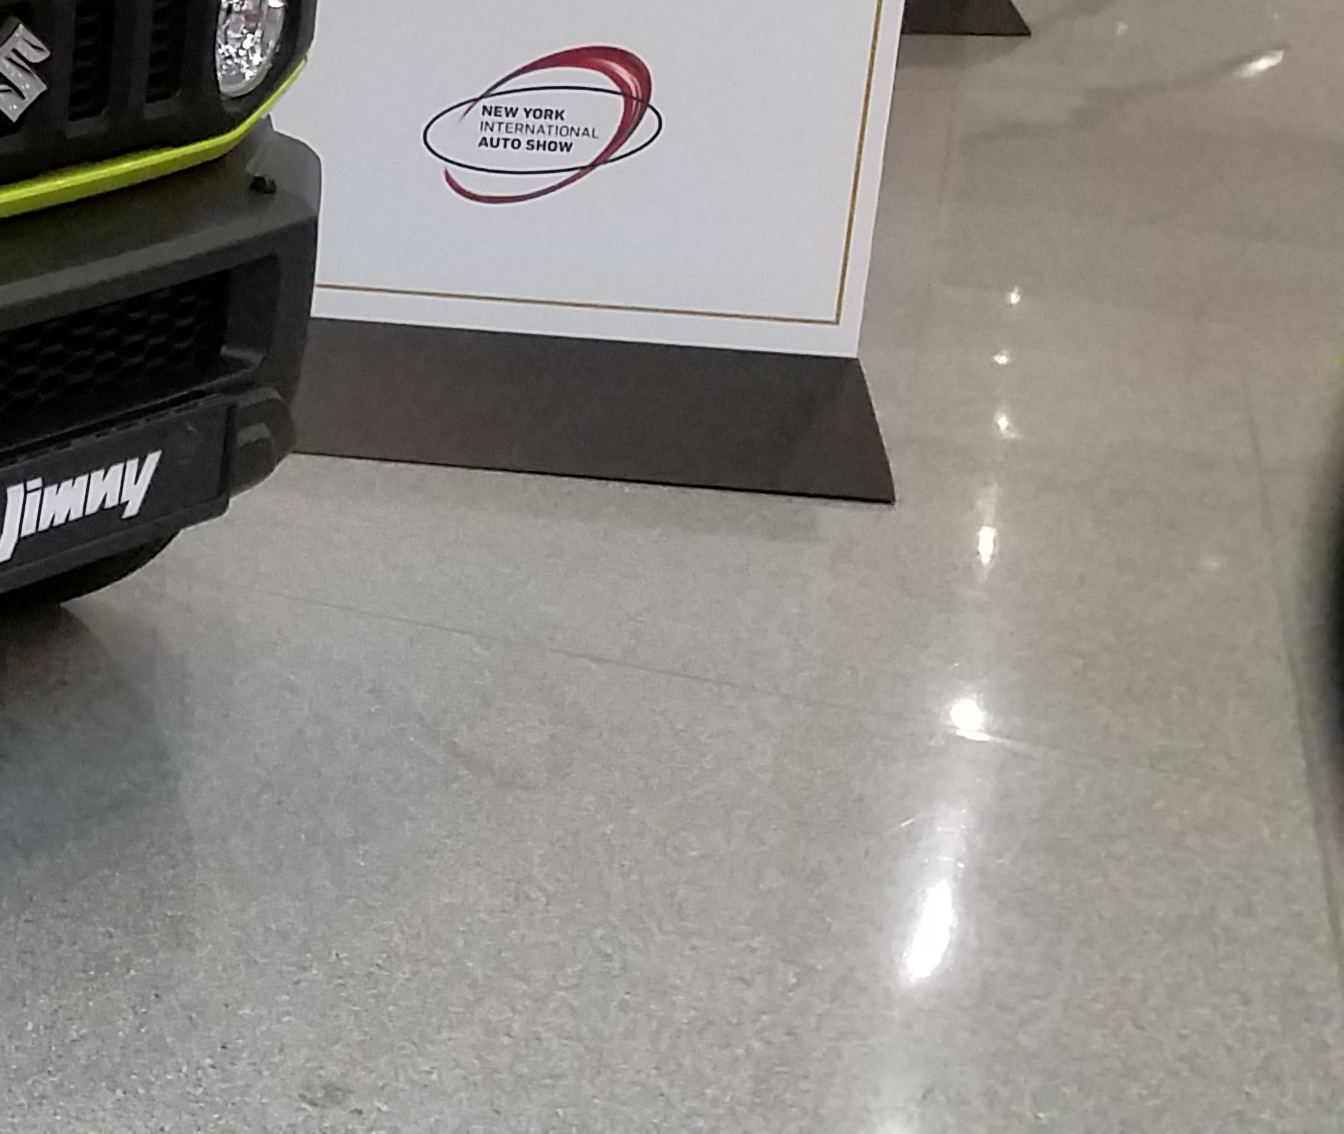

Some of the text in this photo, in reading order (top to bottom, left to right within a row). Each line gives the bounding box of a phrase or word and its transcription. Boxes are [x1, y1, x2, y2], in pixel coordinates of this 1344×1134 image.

[481, 105, 565, 122] NEW YORK
[479, 120, 600, 140] INTERNATIONAL
[478, 136, 573, 153] AUTO SHOW
